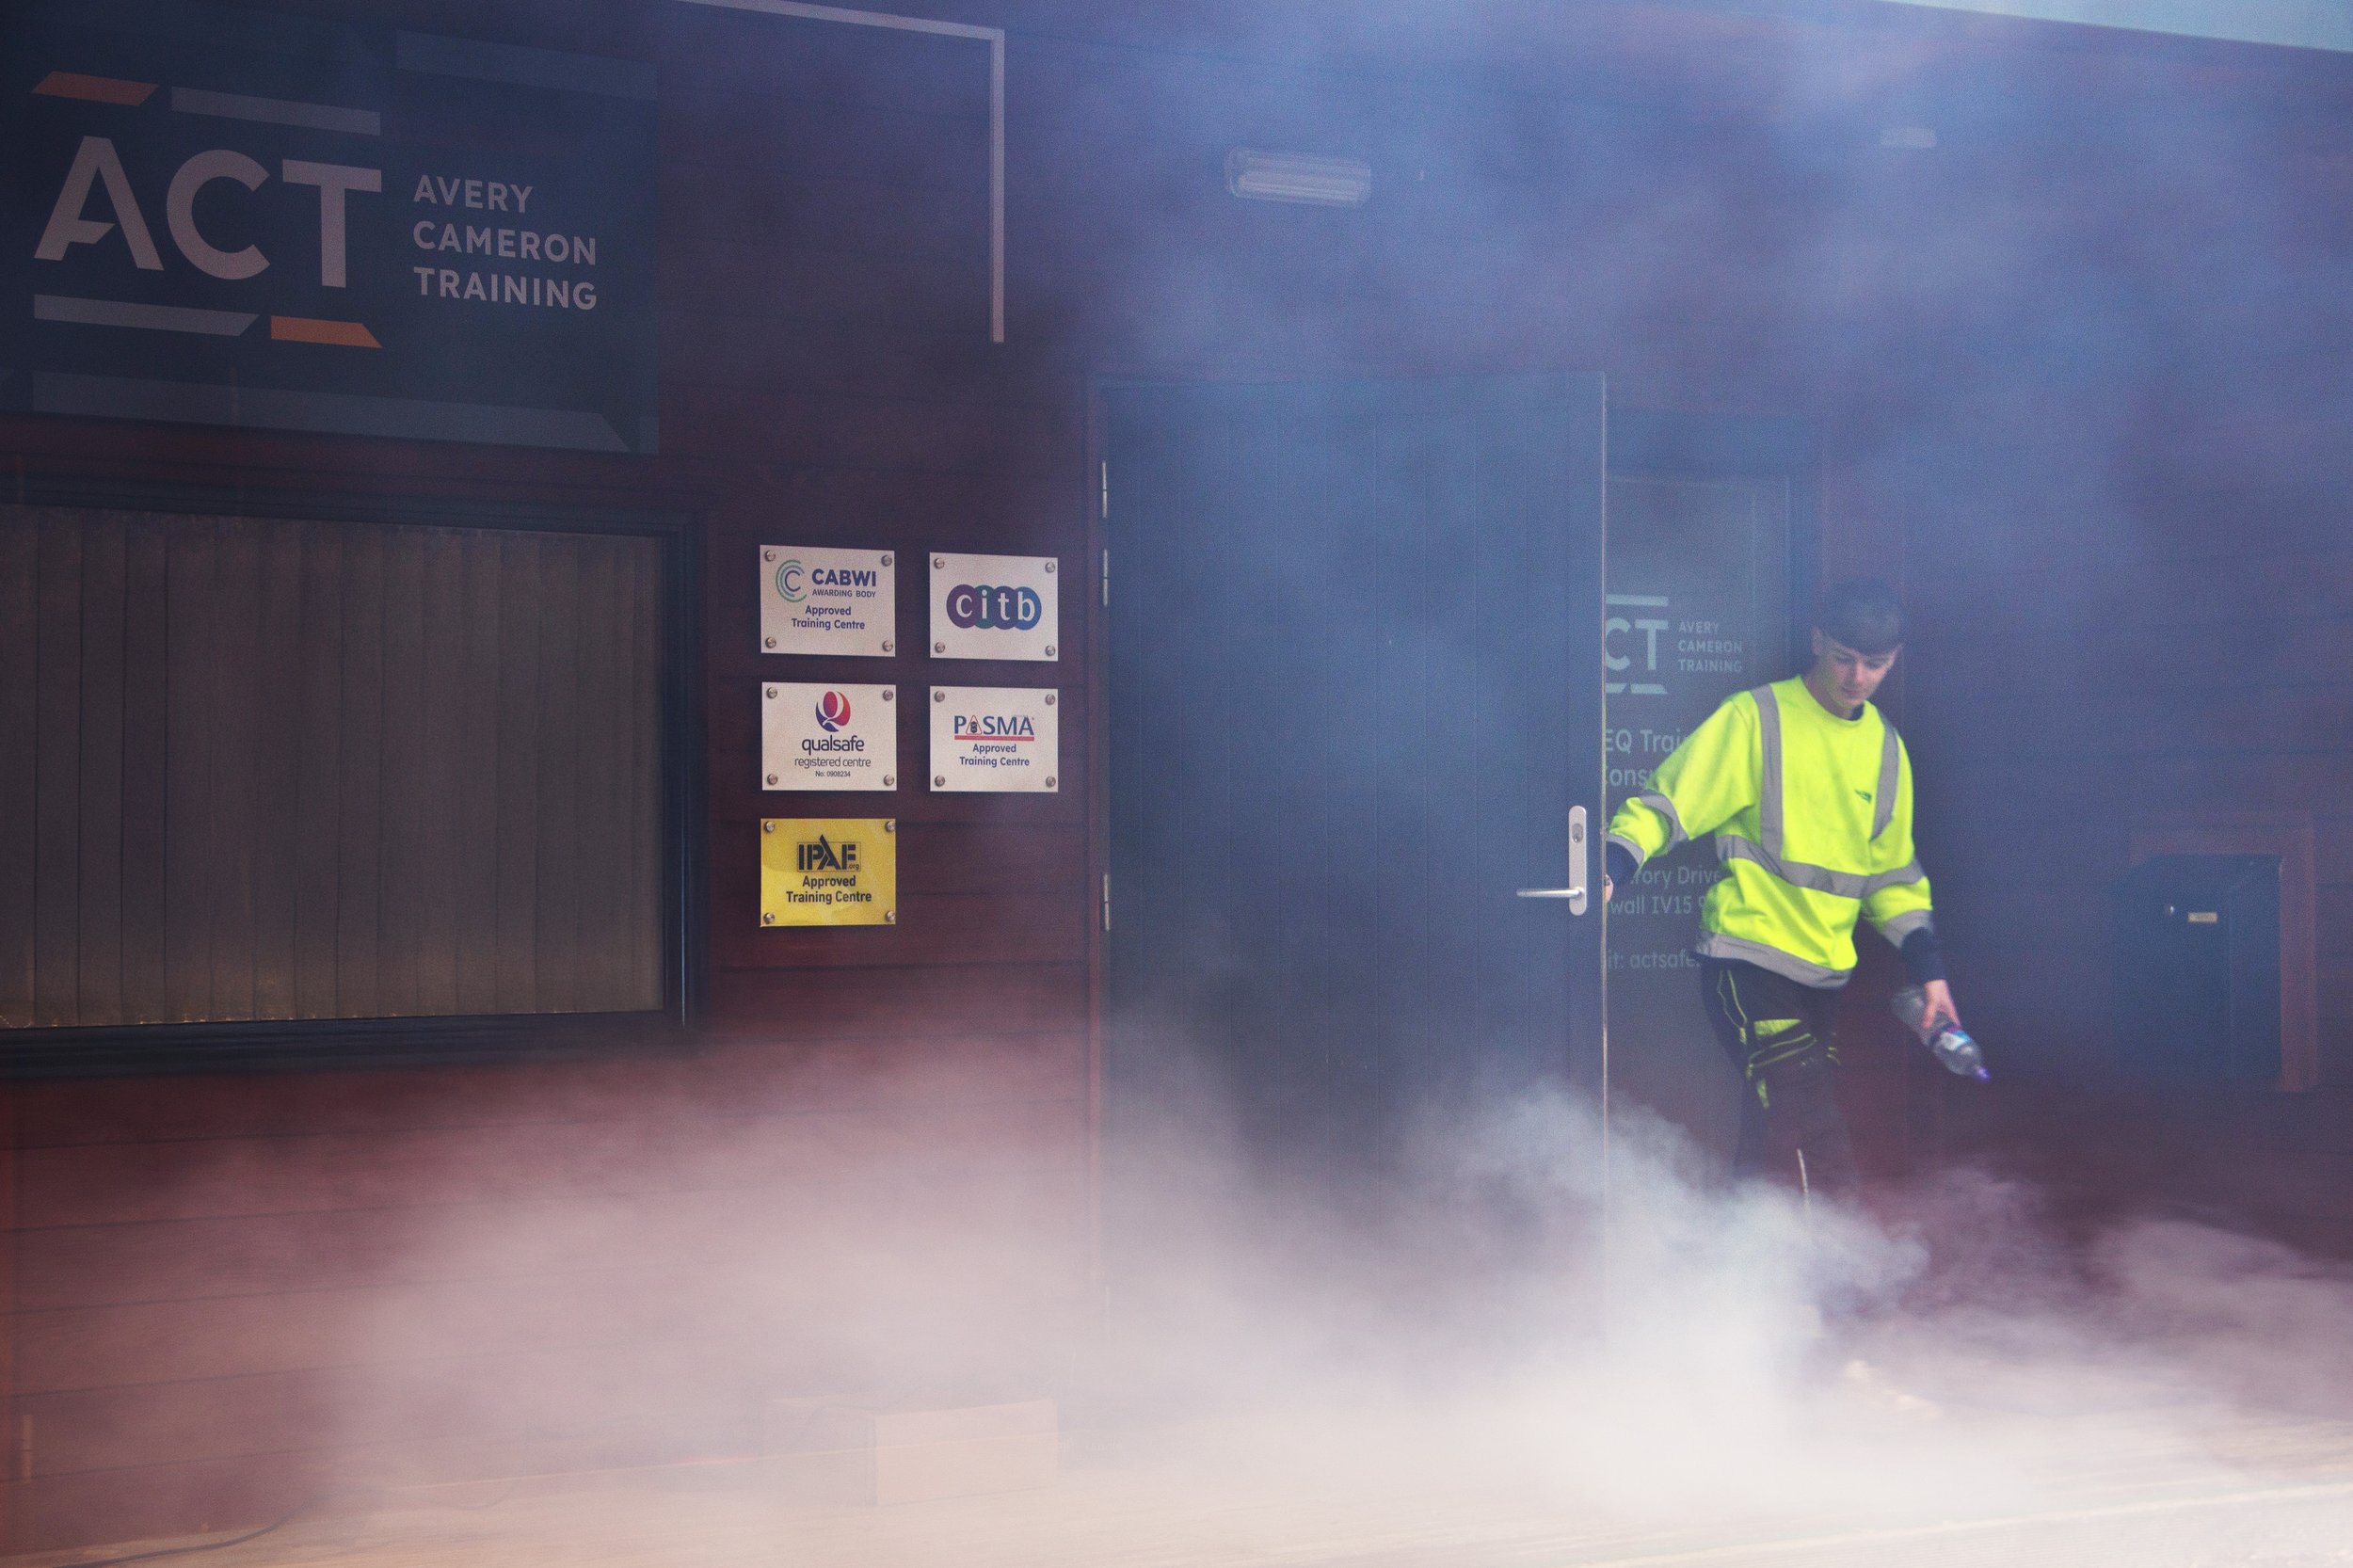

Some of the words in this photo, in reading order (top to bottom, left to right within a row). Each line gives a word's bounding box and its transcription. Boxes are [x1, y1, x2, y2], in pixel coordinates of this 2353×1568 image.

[413, 174, 534, 215] AVERY
[33, 135, 382, 289] ACT
[412, 220, 598, 266] CAMERON
[413, 266, 598, 311] TRAINING
[811, 568, 876, 587] CABWI
[812, 588, 853, 598] AWARDING
[805, 605, 852, 616] Approved
[955, 589, 1035, 621] citb
[791, 618, 831, 631] Training
[834, 619, 866, 630] Centre
[1678, 620, 1721, 634] AVERY
[1606, 616, 1670, 672] CT
[1677, 639, 1743, 654] CAMERON
[1678, 659, 1743, 674] TRAINING
[801, 734, 865, 756] qualsafe
[972, 744, 1017, 755] Approved
[1606, 728, 1633, 755] EQ
[1640, 728, 1686, 753] Trai
[794, 757, 841, 769] registered
[842, 758, 872, 767] centre
[959, 756, 998, 768] Training
[1000, 757, 1031, 766] Centre
[802, 875, 856, 889] Approved
[786, 891, 832, 905] Training
[835, 891, 872, 903] Centre
[1608, 895, 1645, 914] wall
[1629, 948, 1702, 968] actsafe.
